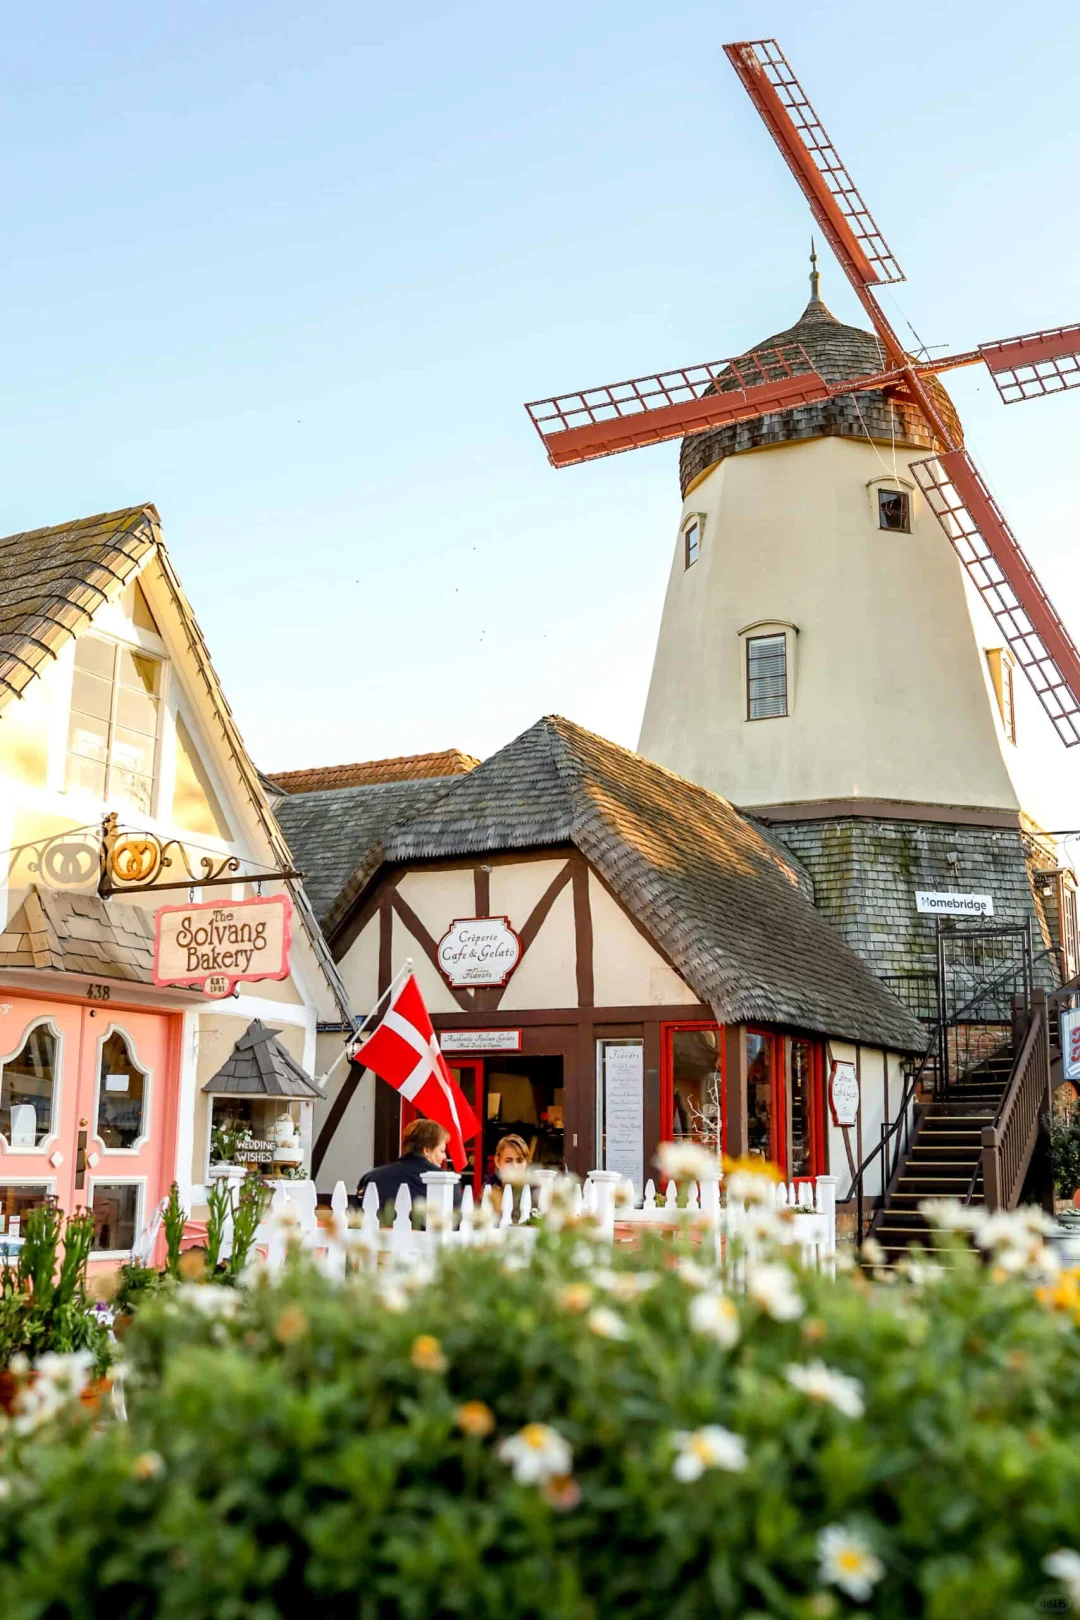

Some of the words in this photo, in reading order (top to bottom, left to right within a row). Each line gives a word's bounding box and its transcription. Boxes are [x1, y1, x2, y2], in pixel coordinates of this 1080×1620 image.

[921, 896, 987, 911] Homebridge
[213, 909, 234, 922] The
[176, 916, 267, 950] Solvang
[469, 949, 477, 958] &
[477, 942, 515, 961] Gelato
[186, 946, 254, 973] Bakery
[462, 967, 493, 980] Flavors
[210, 977, 225, 985] EST
[86, 983, 110, 1001] 438
[236, 1140, 276, 1150] WEDDING
[236, 1151, 272, 1162] WISHES
